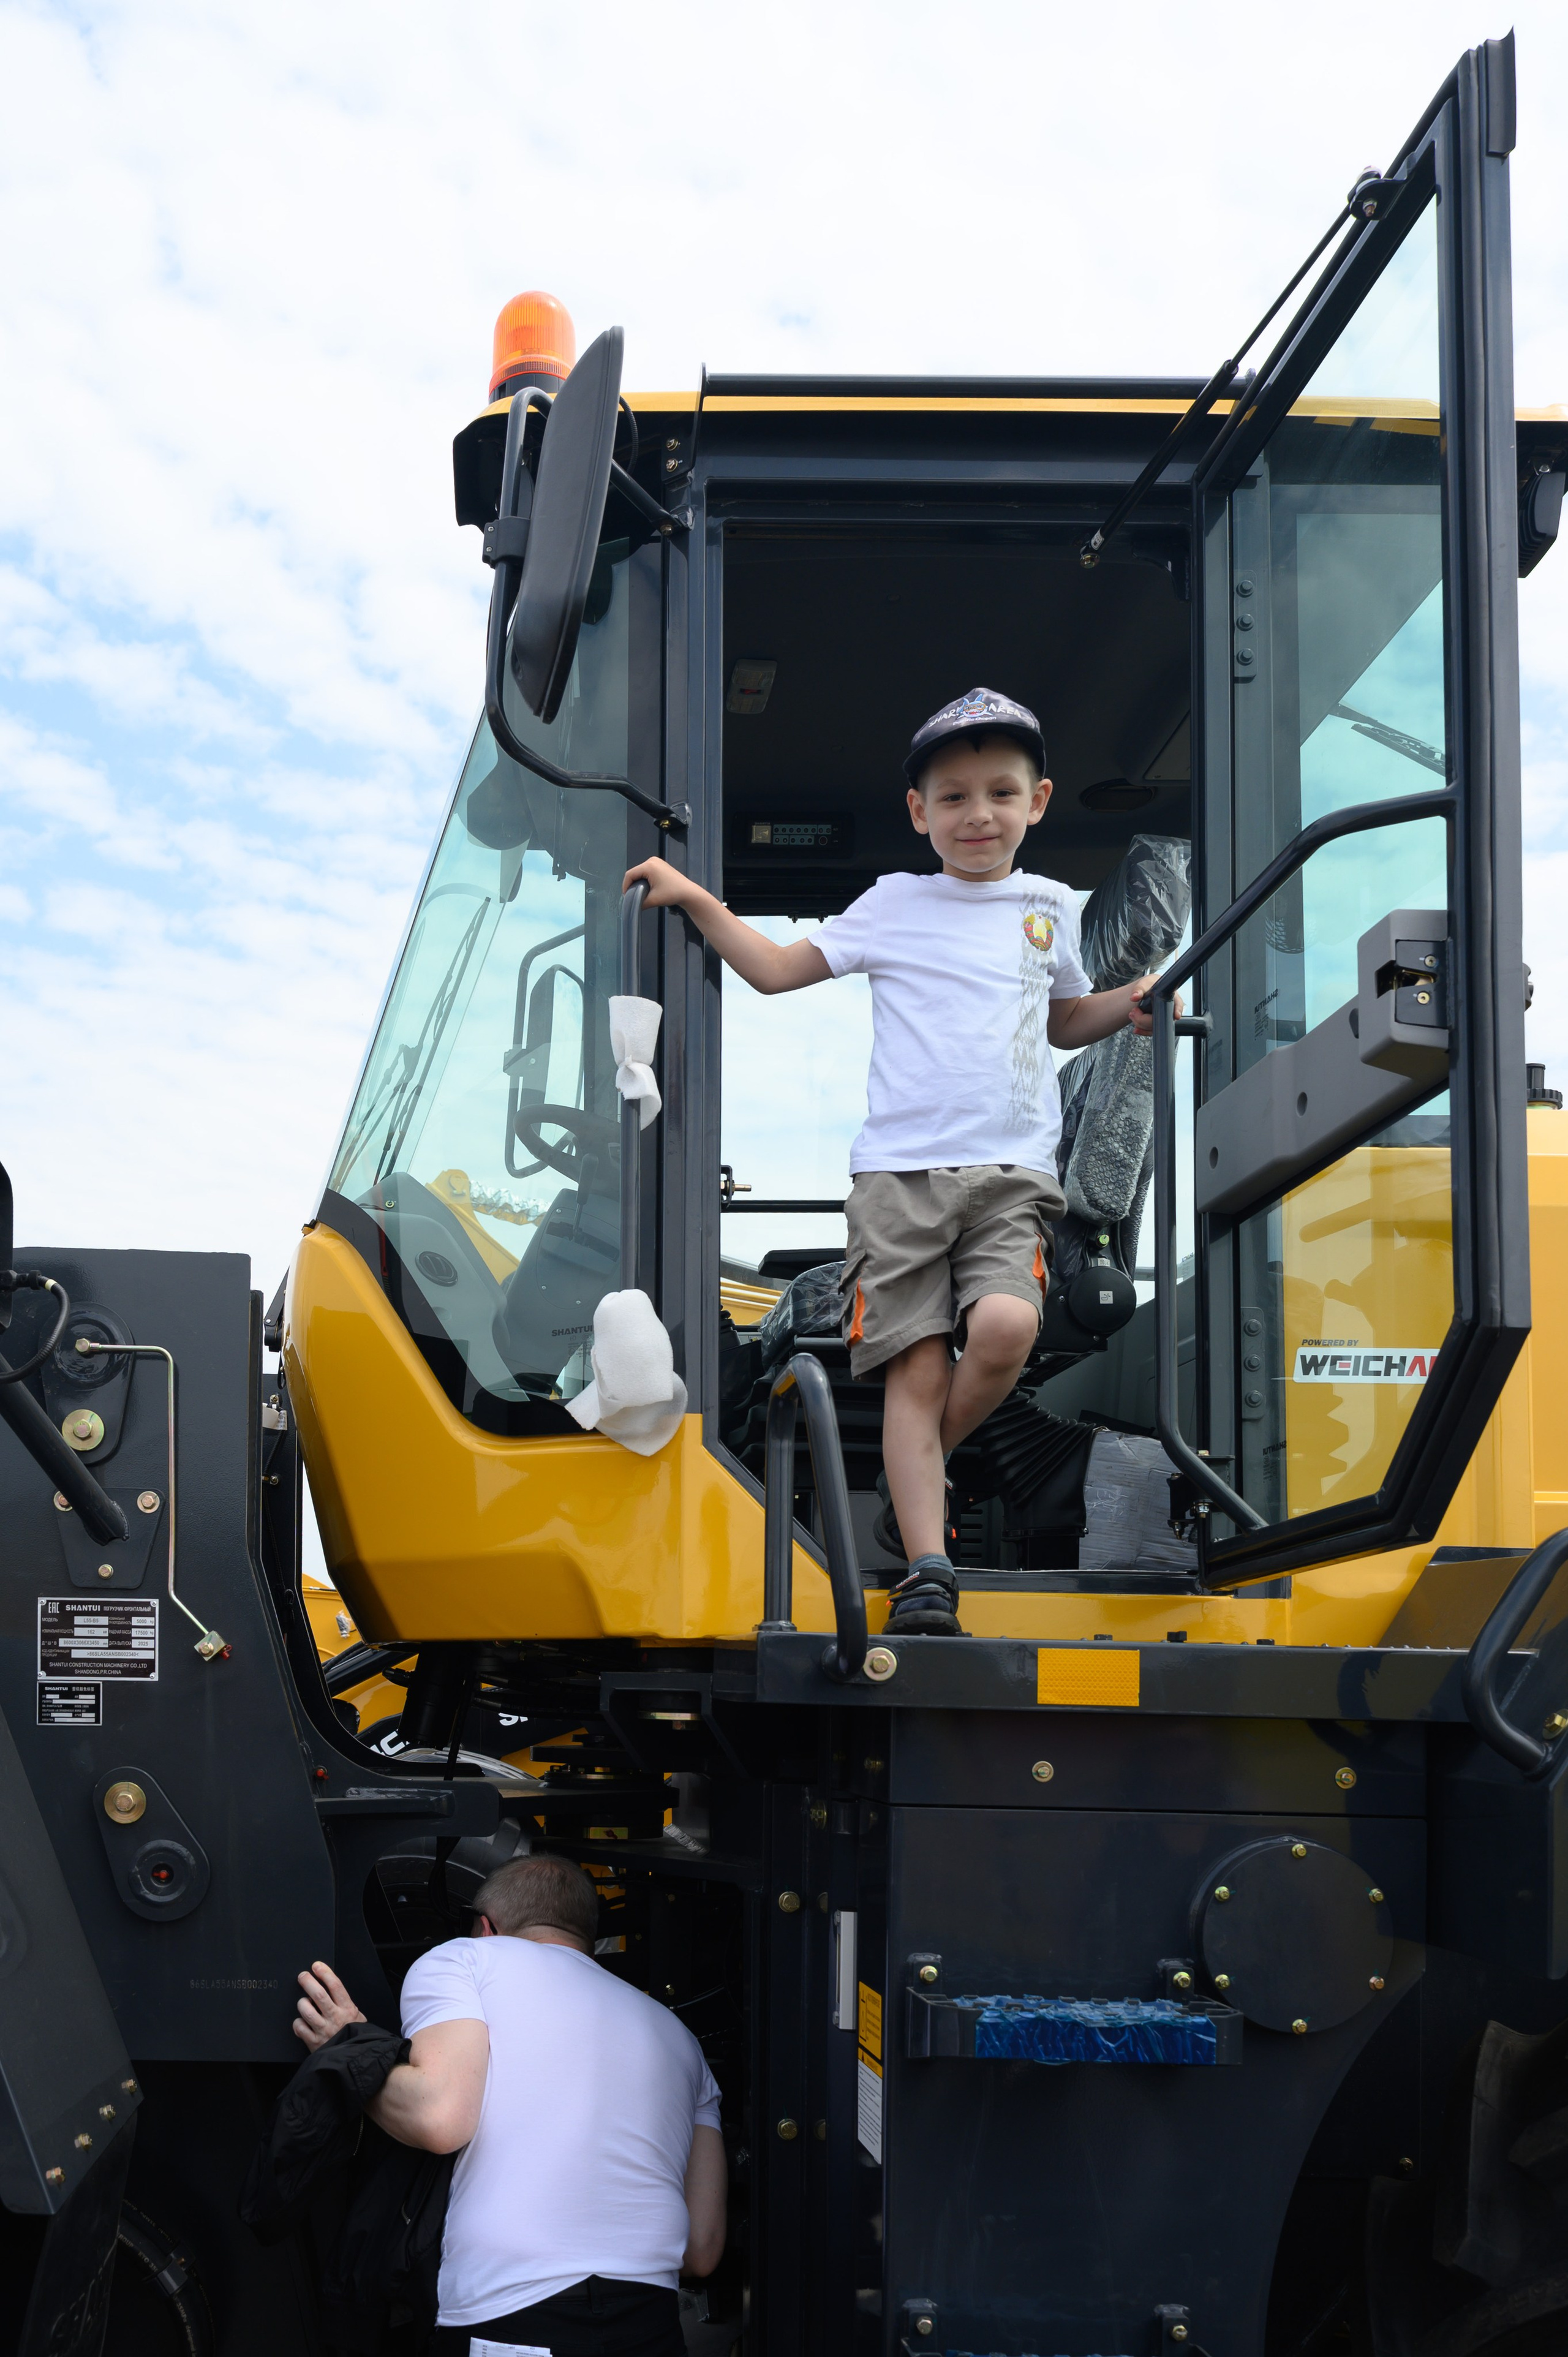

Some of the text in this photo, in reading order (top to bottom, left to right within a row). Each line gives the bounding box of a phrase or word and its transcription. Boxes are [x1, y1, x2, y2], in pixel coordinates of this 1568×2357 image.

[989, 703, 1022, 718] AREA
[551, 1325, 593, 1337] SHANTUI
[48, 1602, 59, 1613] EAC
